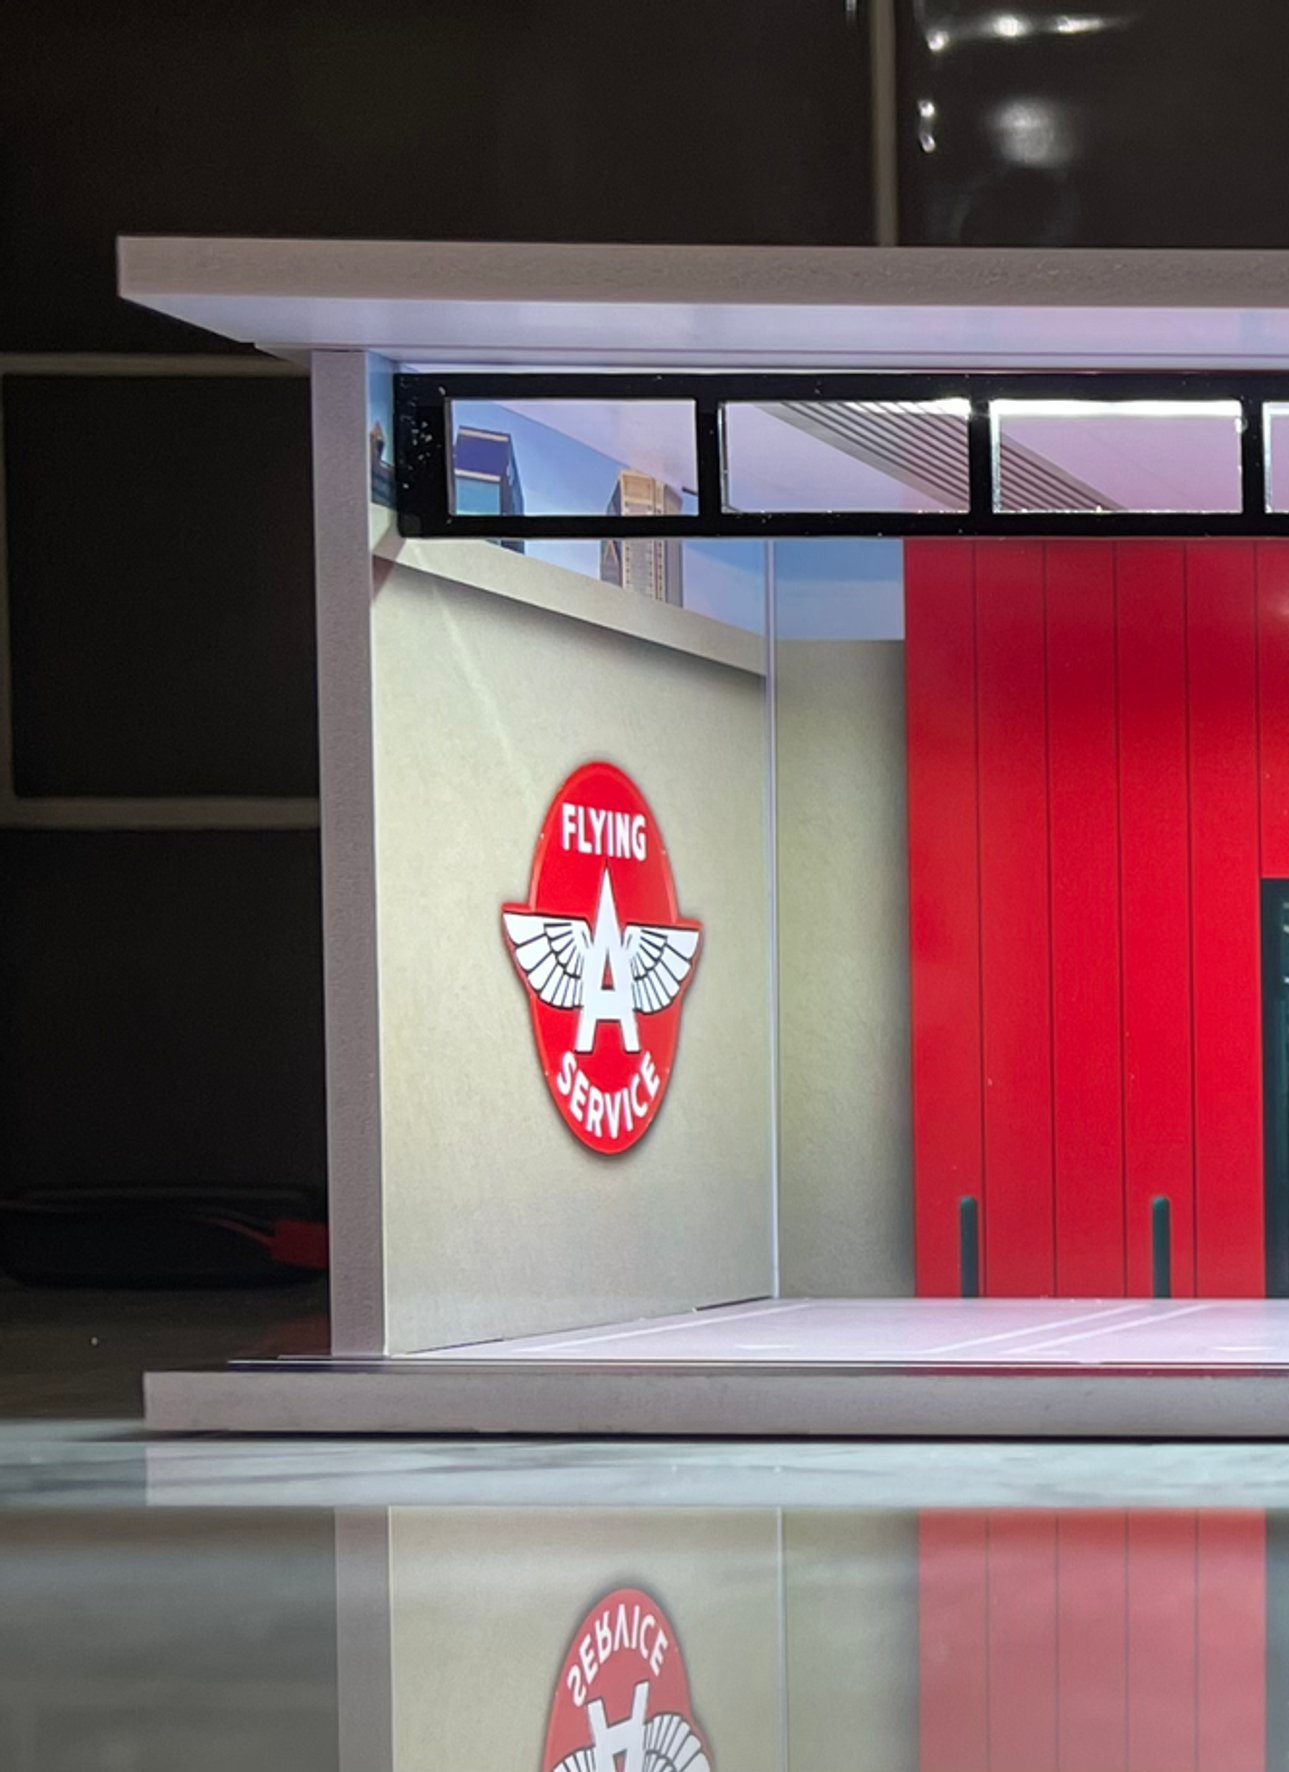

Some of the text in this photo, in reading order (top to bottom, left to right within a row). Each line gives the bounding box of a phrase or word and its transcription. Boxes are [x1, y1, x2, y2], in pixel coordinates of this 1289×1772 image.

[561, 802, 647, 862] FLYING
[574, 858, 642, 1054] A
[555, 1050, 661, 1140] SERVICE
